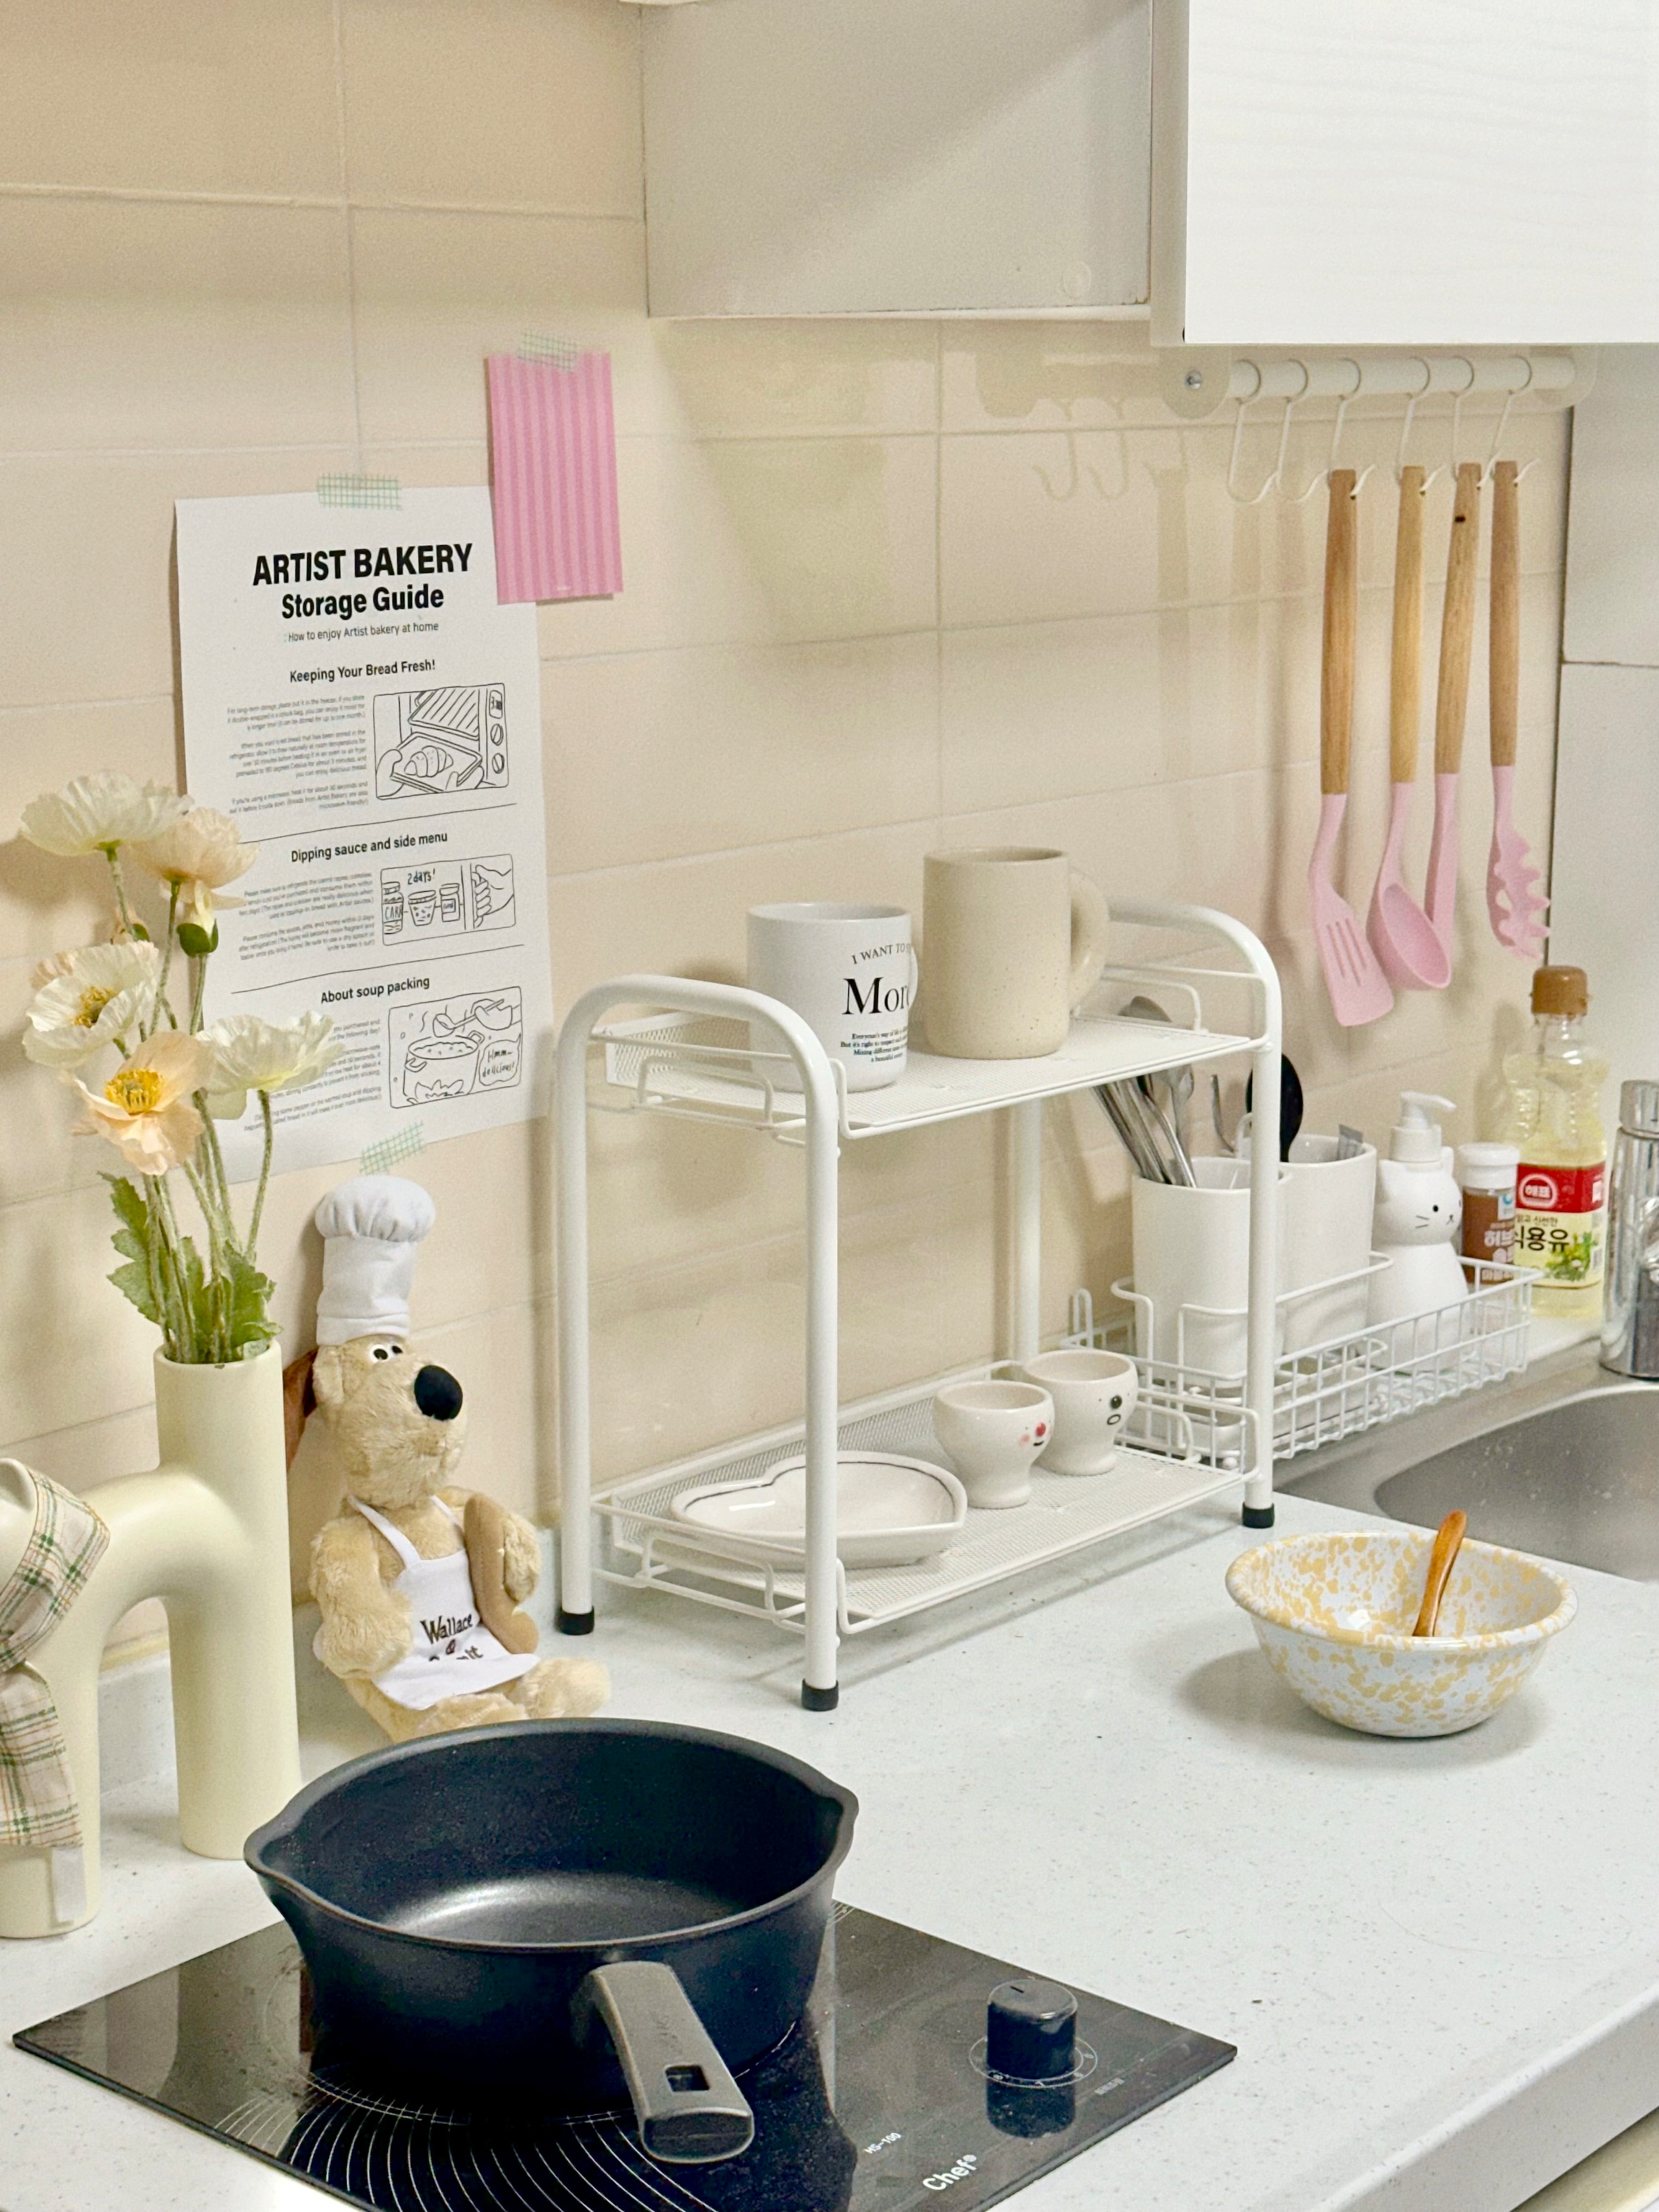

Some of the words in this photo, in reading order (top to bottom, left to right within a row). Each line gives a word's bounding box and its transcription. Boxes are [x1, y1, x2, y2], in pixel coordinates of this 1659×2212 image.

[253, 550, 346, 585] ARTIST
[354, 543, 472, 577] BAKERY
[282, 594, 367, 620] Storage
[373, 583, 444, 611] Guide
[288, 632, 305, 642] How
[307, 631, 315, 640] to
[318, 629, 341, 641] enjoy
[344, 627, 367, 636] Artist
[370, 625, 399, 636] bakery
[402, 623, 411, 633] at
[413, 623, 439, 631] home
[290, 668, 334, 683] Keeping
[338, 666, 362, 678] Your
[366, 662, 398, 675] Bread
[401, 659, 435, 673] Fresh!
[292, 846, 331, 863] Dipping
[334, 843, 367, 856] sauce
[371, 837, 391, 852] and
[393, 835, 416, 848] side
[419, 833, 447, 844] menu
[852, 955, 857, 964] I
[860, 944, 893, 960] WANT
[896, 943, 905, 953] TO
[321, 988, 353, 1004] About
[356, 984, 384, 997] soup
[388, 977, 430, 995] packing
[842, 977, 909, 1015] Mor
[420, 1614, 472, 1645] Wallace
